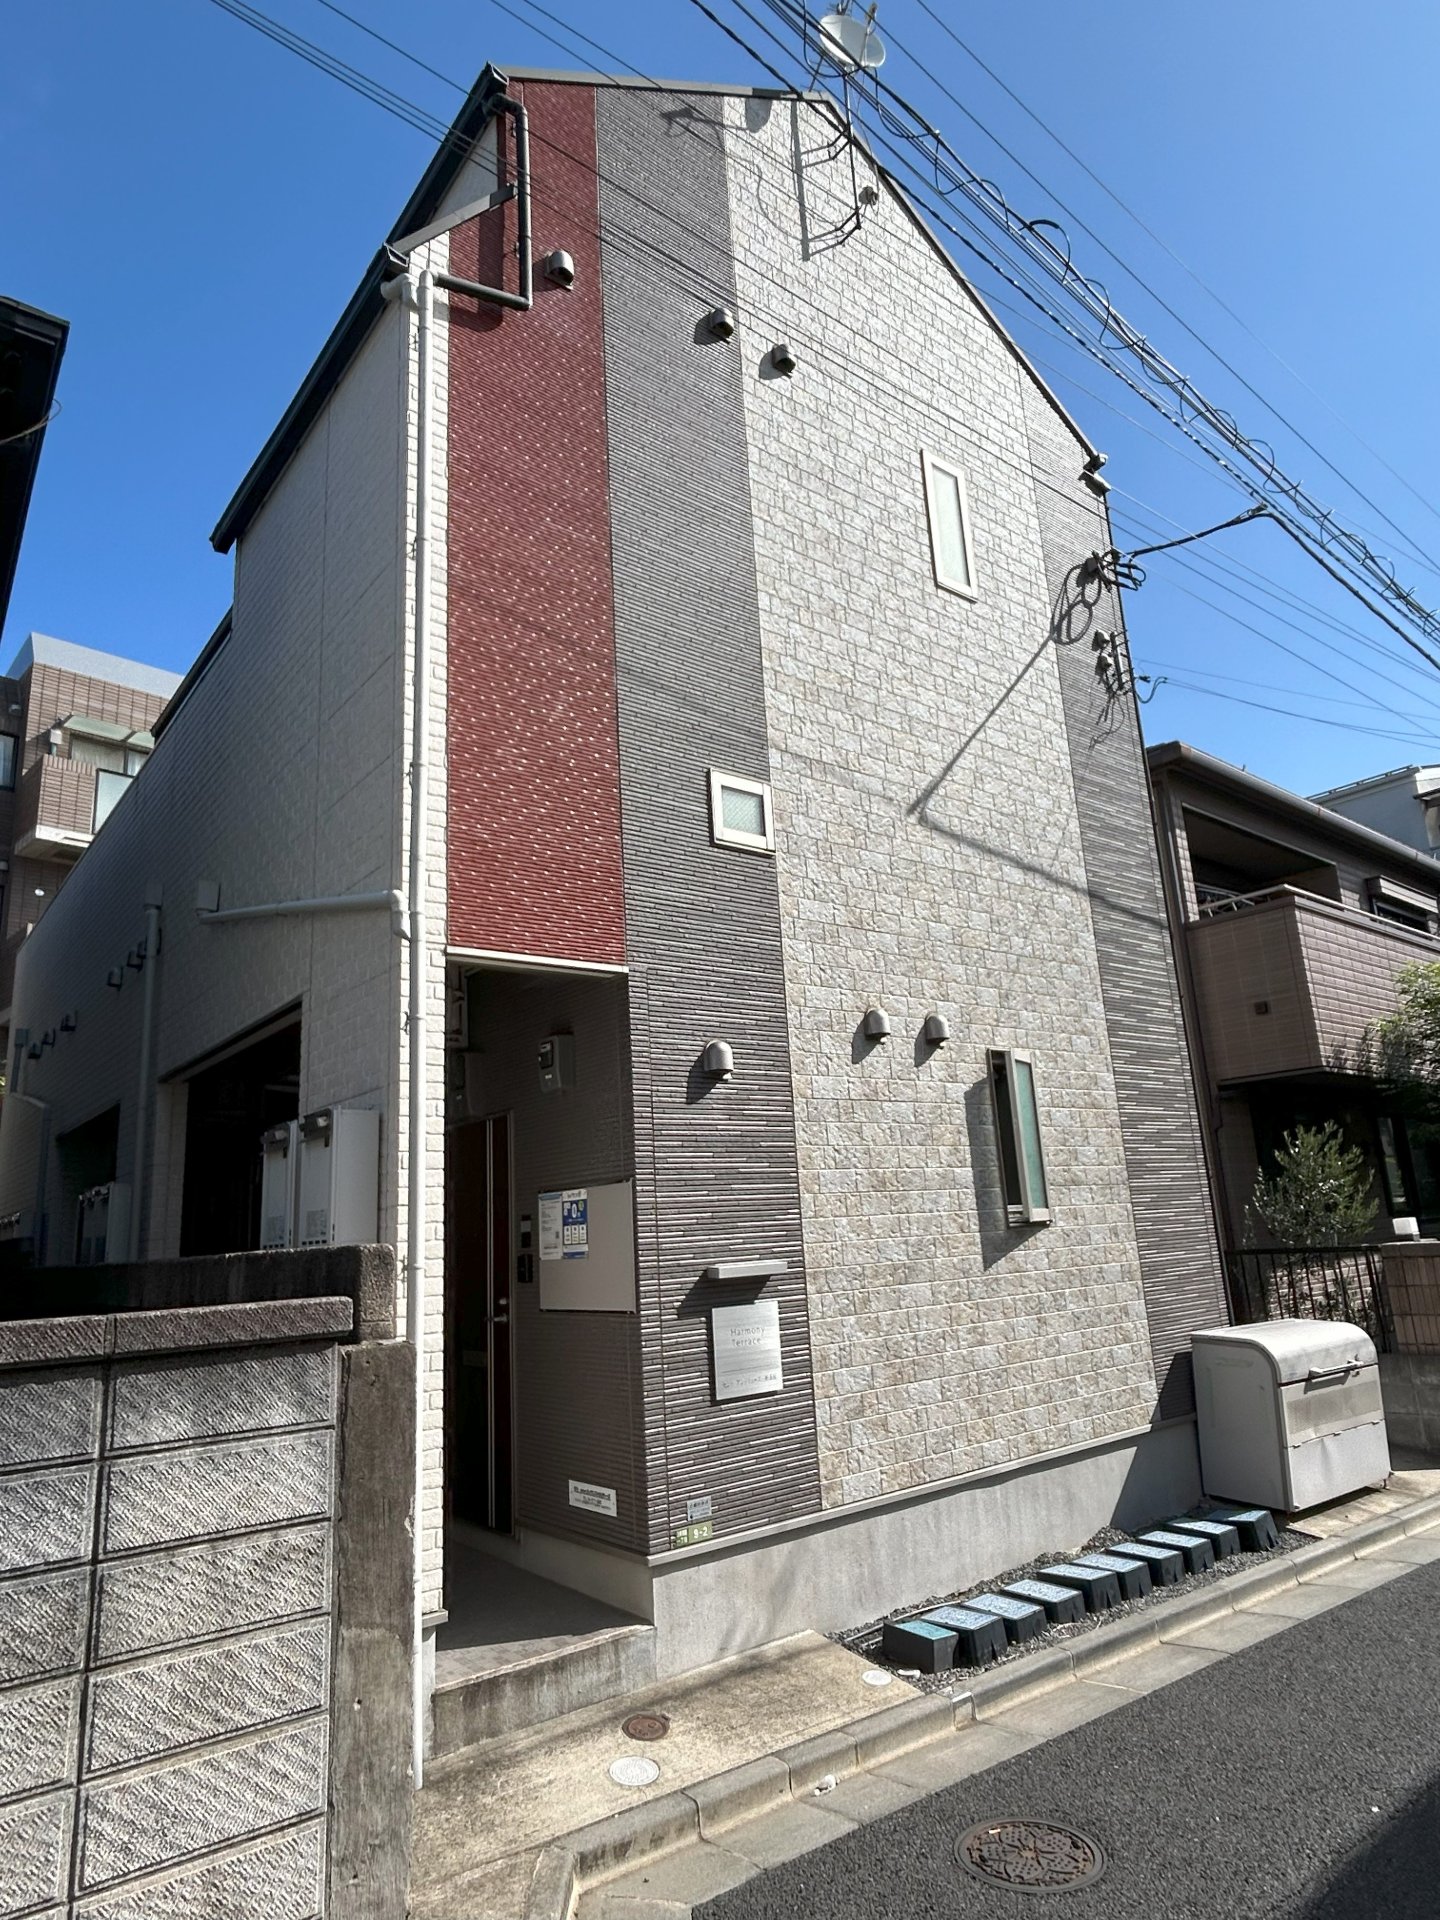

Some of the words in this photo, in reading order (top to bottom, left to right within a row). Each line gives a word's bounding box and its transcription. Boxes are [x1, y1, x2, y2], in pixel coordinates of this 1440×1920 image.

[730, 1327, 765, 1337] Harmony
[731, 1337, 761, 1347] Terrace
[693, 1526, 708, 1539] 9-2
